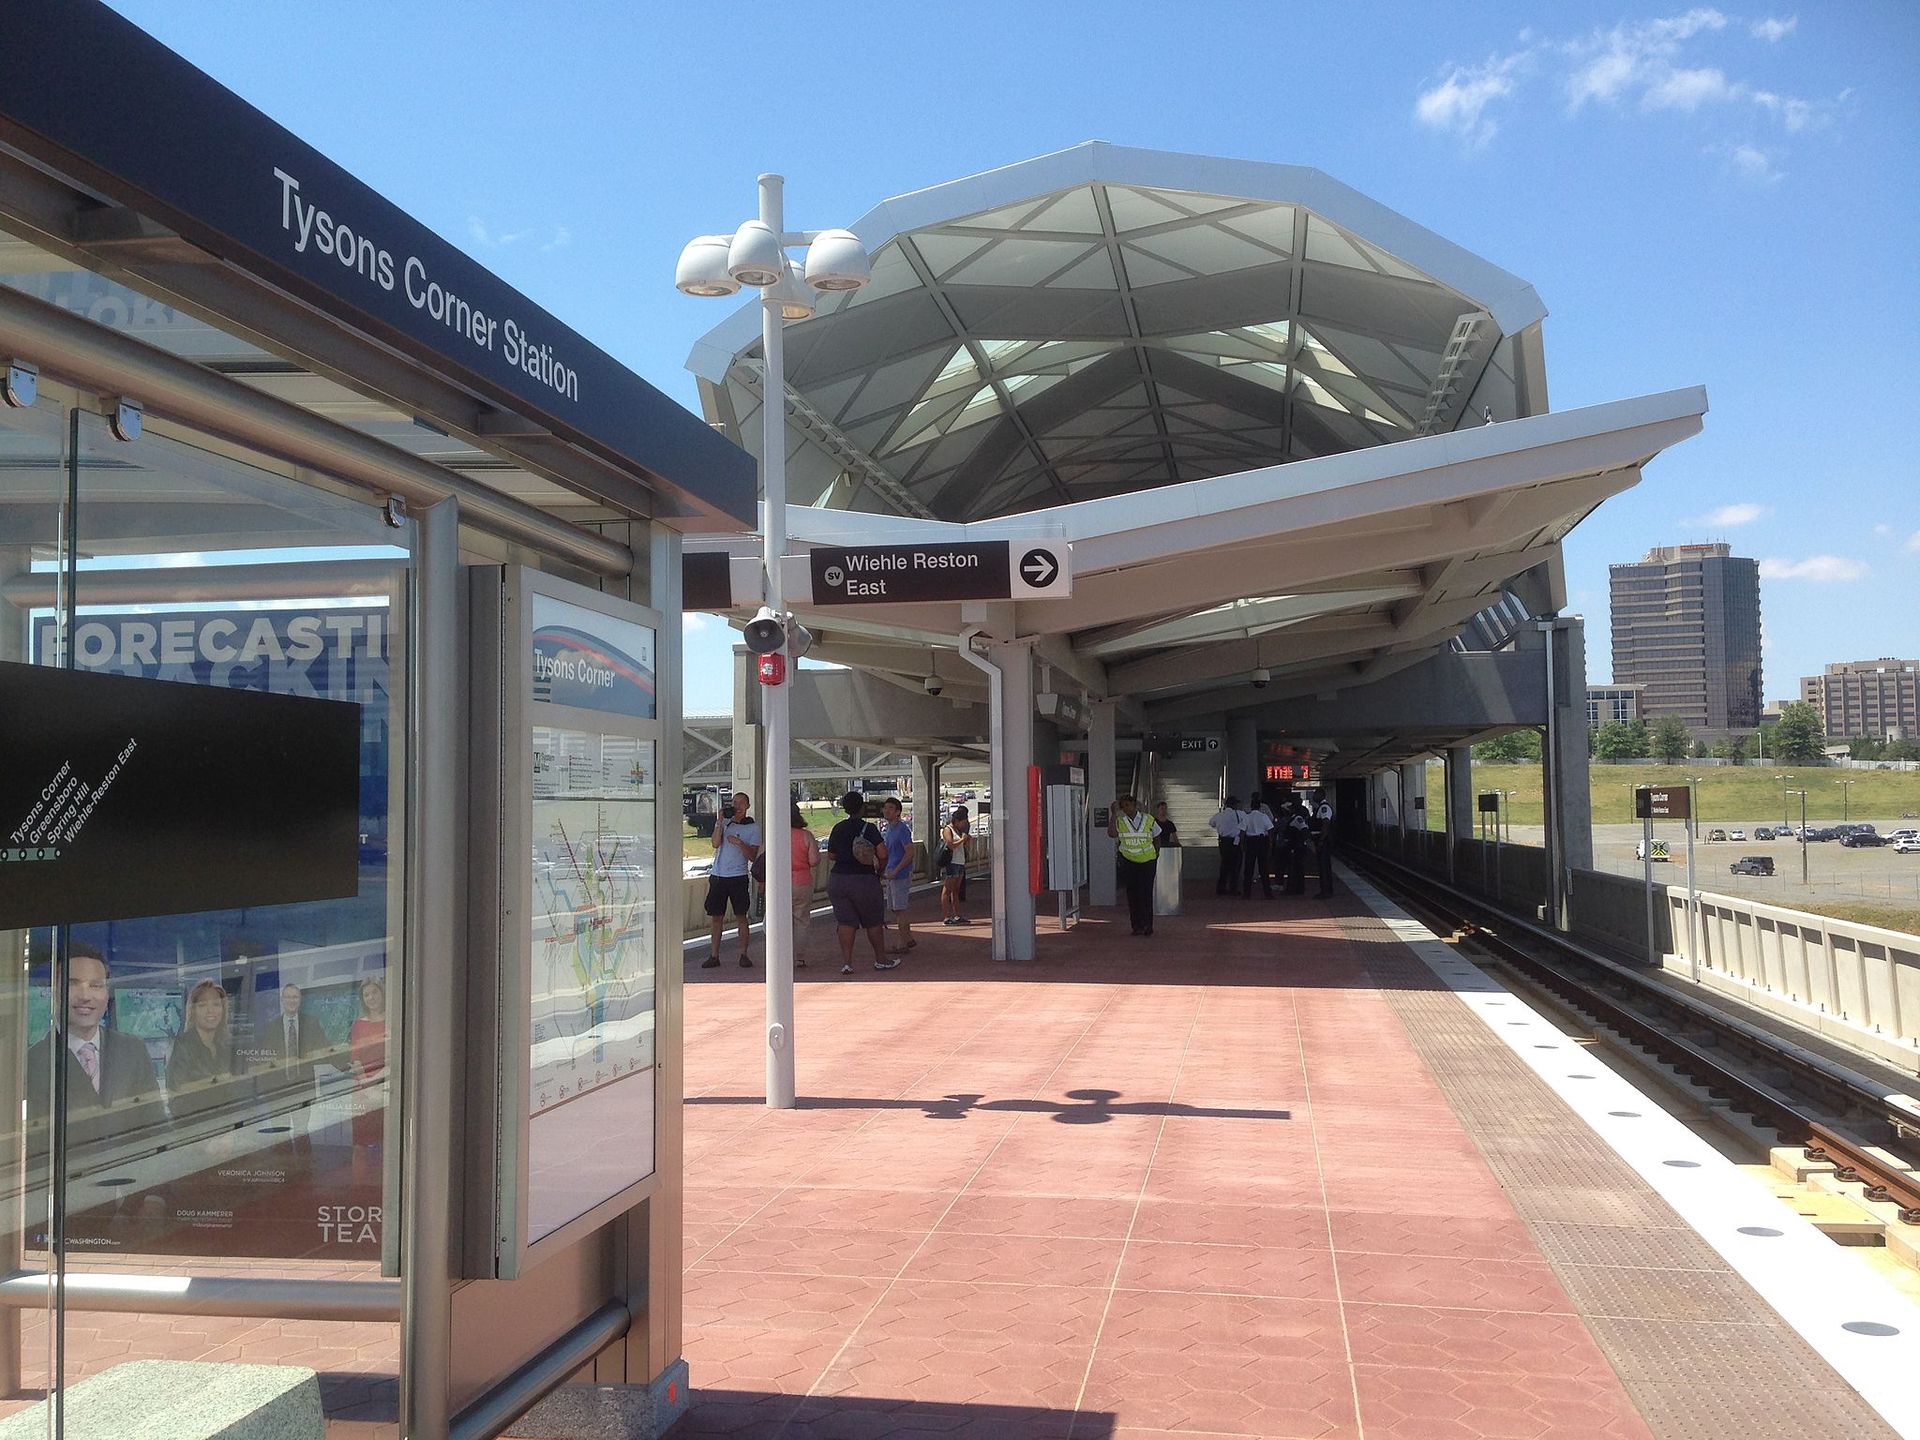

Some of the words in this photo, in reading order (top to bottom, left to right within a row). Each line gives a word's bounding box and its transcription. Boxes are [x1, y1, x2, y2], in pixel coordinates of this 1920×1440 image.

[273, 166, 394, 291] Tysons
[404, 256, 497, 351] Corner
[503, 319, 578, 402] Station
[827, 572, 841, 580] SV
[845, 554, 908, 572] Wiehle
[913, 552, 978, 569] Reston
[846, 579, 887, 596] East
[42, 614, 389, 668] FORECASTI
[534, 648, 575, 680] Tysons
[577, 658, 616, 688] Corner
[1181, 740, 1202, 749] EXIT
[10, 801, 44, 844] Tysons
[41, 760, 71, 801] Corner
[63, 764, 120, 843] Wiehle-Reston
[117, 737, 137, 765] East
[29, 777, 78, 844] Greensboro
[47, 804, 77, 844] Spring
[73, 782, 90, 805] Hill
[317, 1205, 383, 1223] STOR
[317, 1223, 377, 1243] TEA
